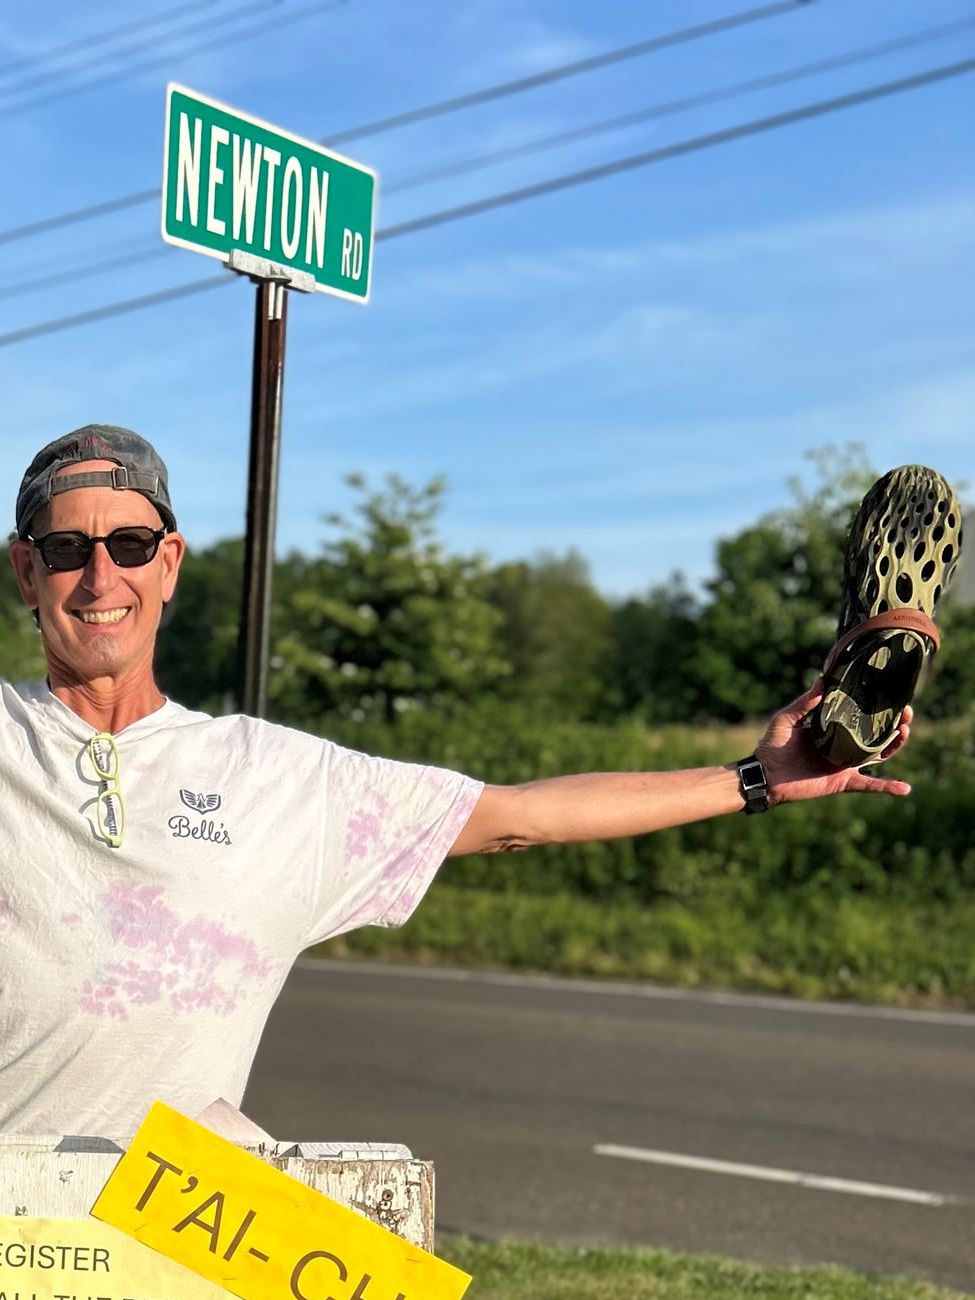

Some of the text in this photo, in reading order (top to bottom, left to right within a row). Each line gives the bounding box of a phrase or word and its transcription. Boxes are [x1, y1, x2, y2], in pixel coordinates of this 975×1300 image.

[175, 111, 363, 281] NEWTON RD
[167, 815, 233, 846] Belle's
[133, 1151, 271, 1264] T'AI-
